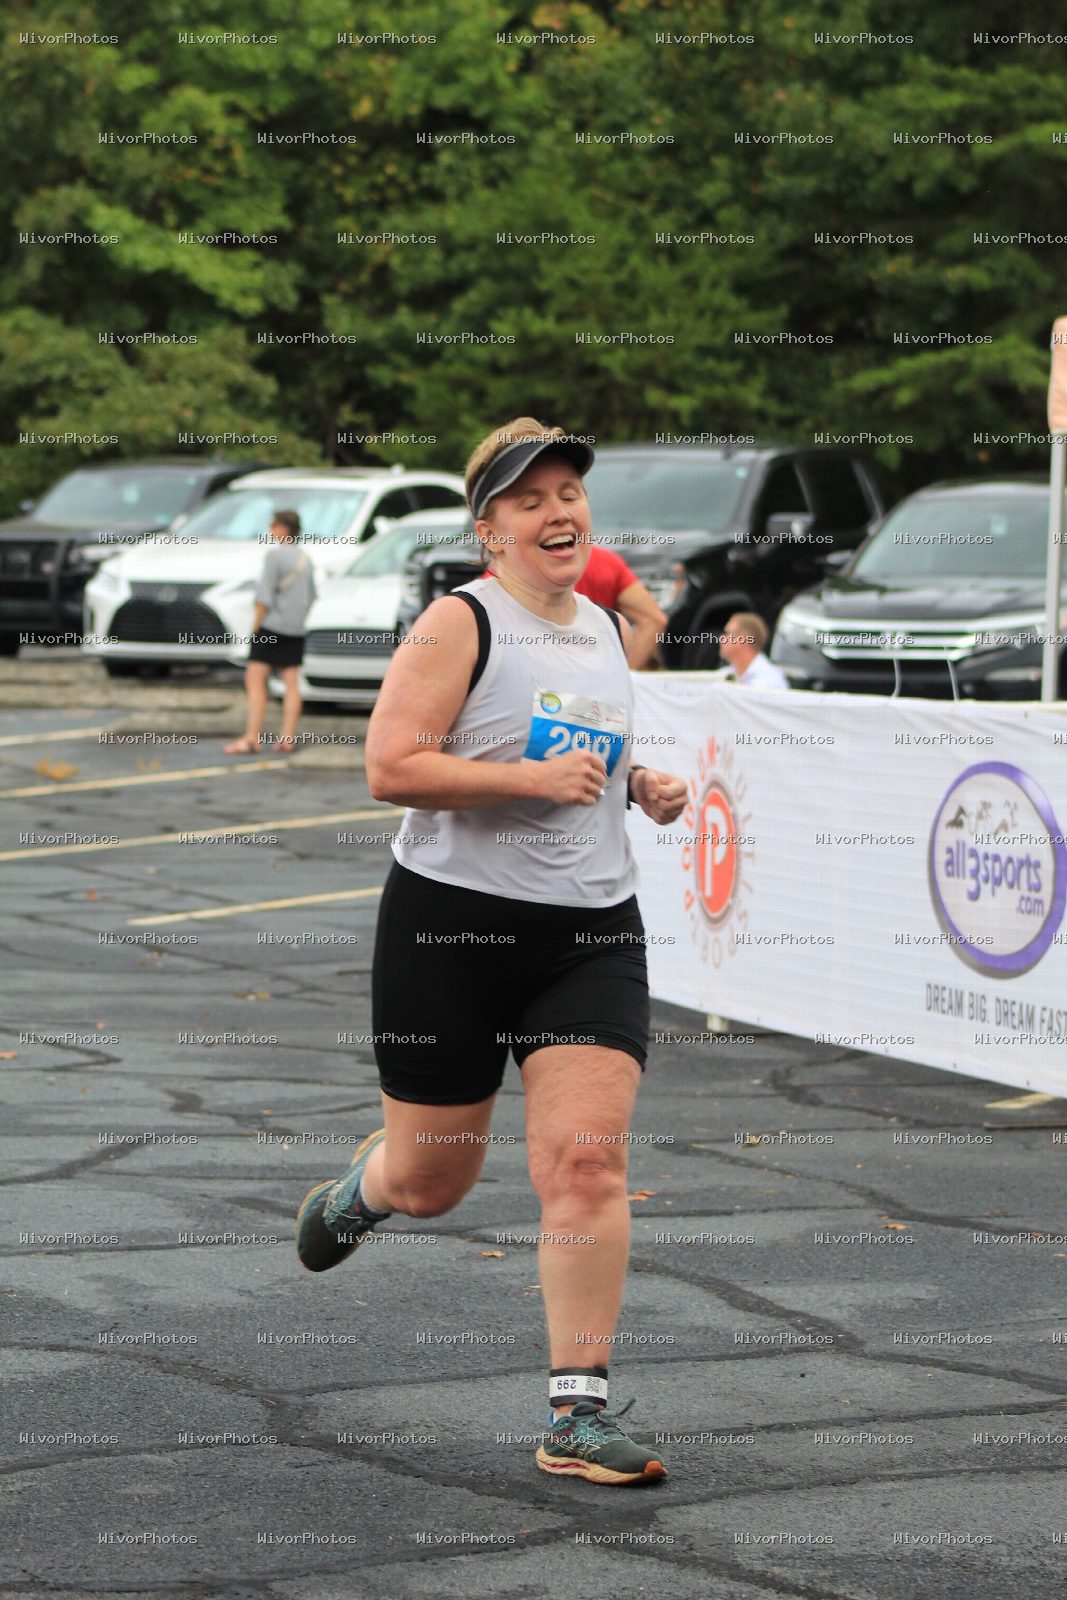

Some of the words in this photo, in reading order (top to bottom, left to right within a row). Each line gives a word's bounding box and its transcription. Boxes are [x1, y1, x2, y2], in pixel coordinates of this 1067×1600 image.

[944, 839, 1042, 902] all3sports
[926, 983, 964, 1018] DREAM
[995, 997, 1035, 1034] DREAM
[557, 1380, 577, 1390] 299
